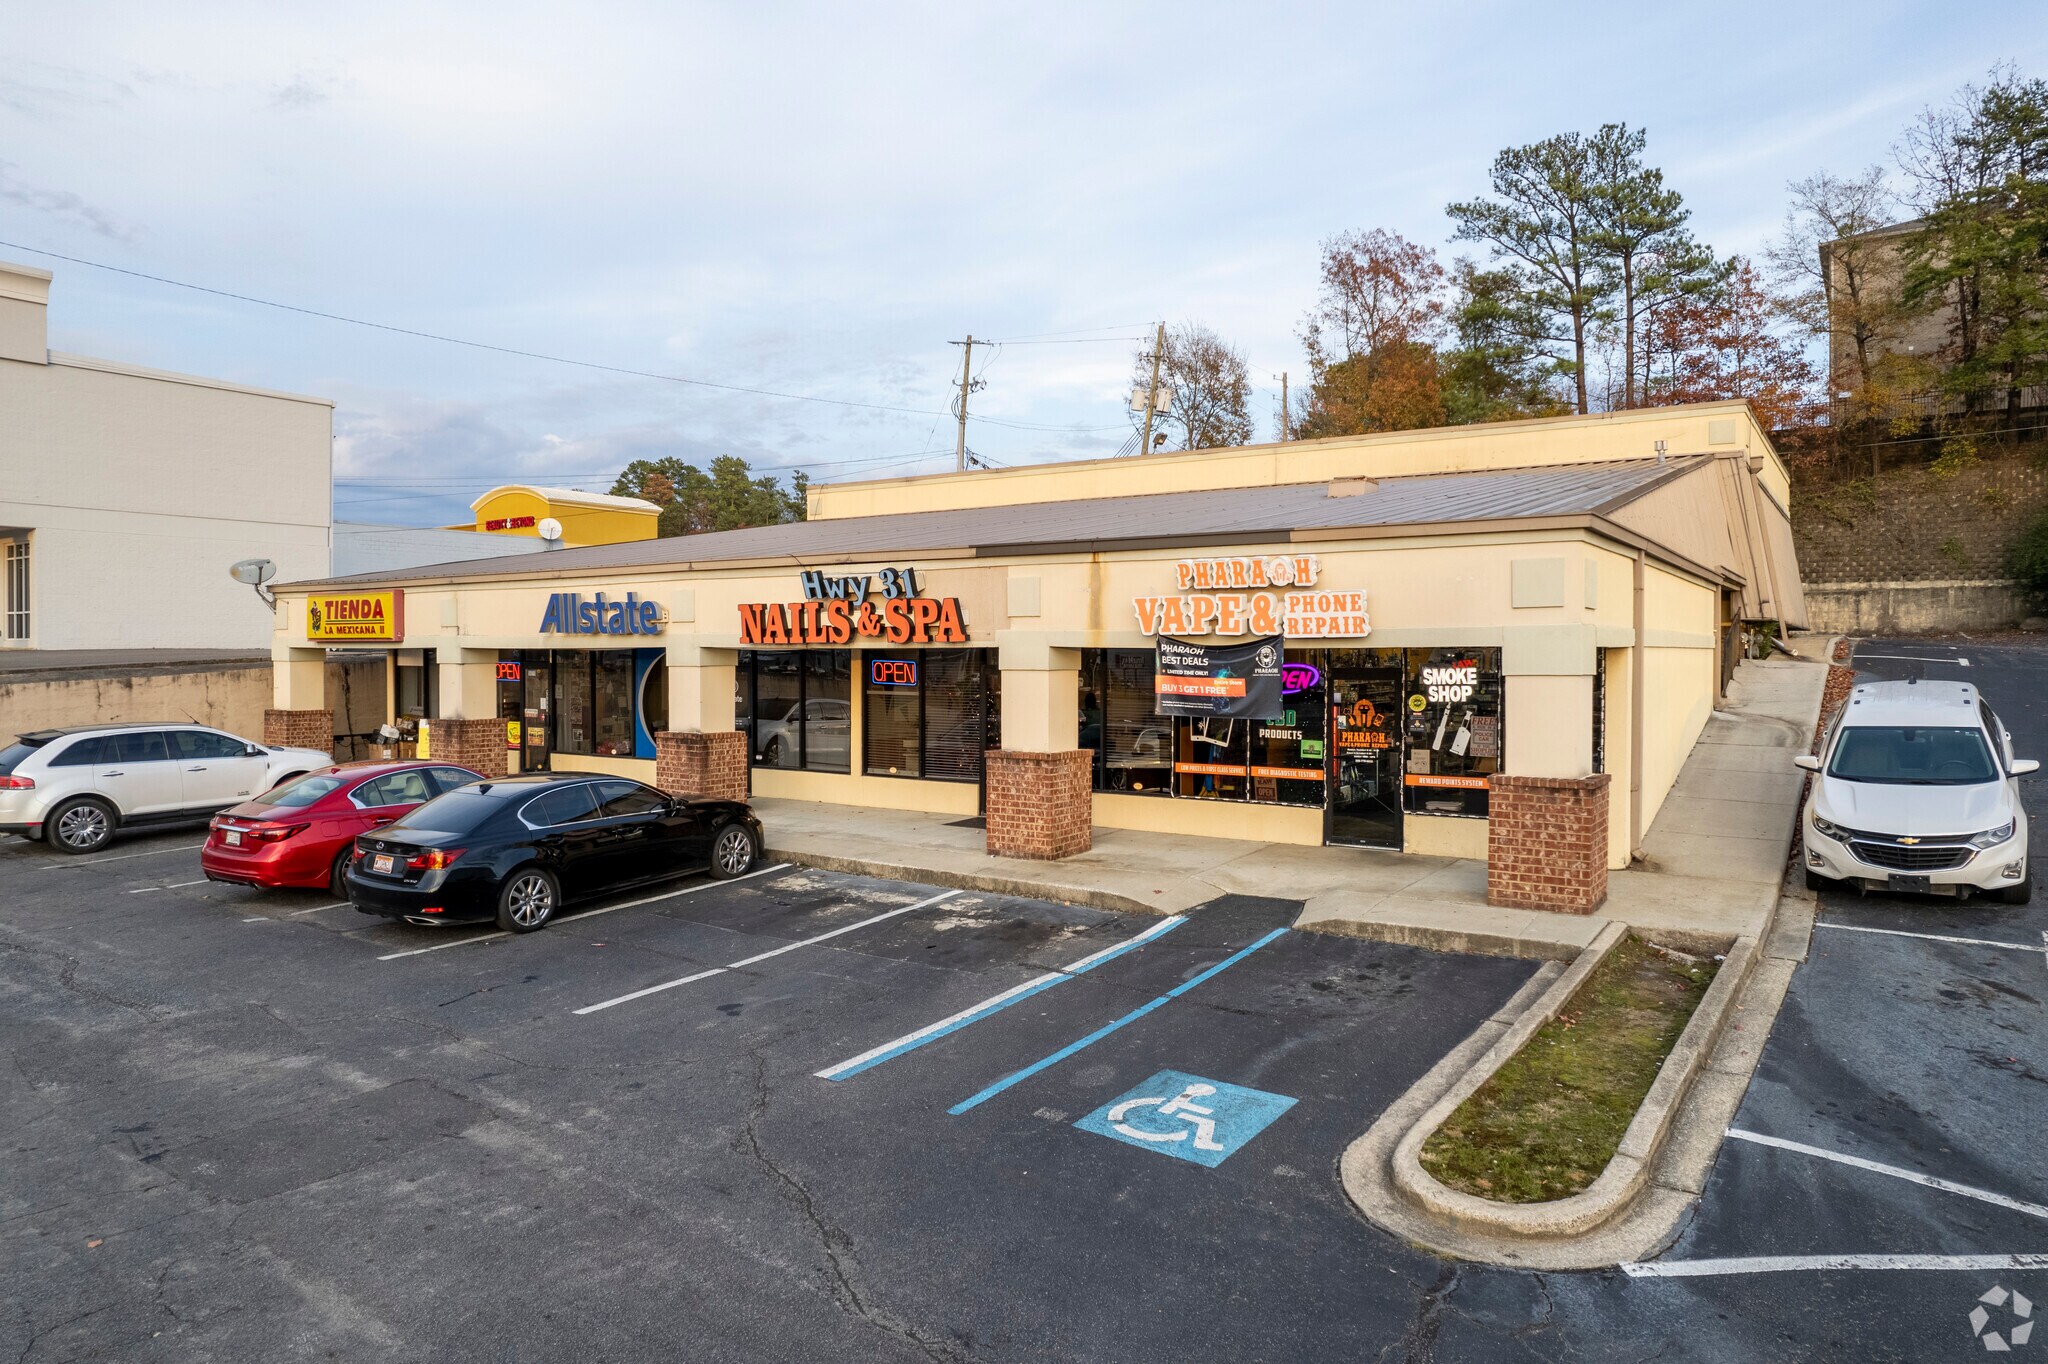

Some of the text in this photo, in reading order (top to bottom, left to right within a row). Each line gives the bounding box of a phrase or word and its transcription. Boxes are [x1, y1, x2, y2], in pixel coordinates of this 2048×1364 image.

[1176, 557, 1314, 589] PHARAOH
[801, 567, 919, 605] Hwy 31
[324, 599, 384, 620] TIENDA
[1289, 594, 1362, 613] PHONE
[539, 592, 661, 635] Allstate
[1134, 594, 1277, 635] VAPE &
[324, 626, 333, 635] LA
[336, 625, 376, 635] MEXICANA
[1287, 615, 1366, 635] REPAIR
[1161, 644, 1205, 656] PHARAOH
[1161, 656, 1209, 666] BEST DEALS
[495, 663, 520, 680] OPEN
[873, 662, 915, 683] OPEN
[1423, 667, 1477, 685] SMOKE
[1161, 684, 1178, 692] BUY
[1178, 684, 1183, 693] 3
[1184, 685, 1199, 693] GET
[1200, 686, 1205, 694] 1
[1428, 685, 1472, 702] SHOP
[1259, 728, 1303, 740] PRODUCTS
[1341, 731, 1386, 743] PHARAOH
[1270, 769, 1297, 777] DIAGNOSTIC
[1298, 770, 1317, 778] TESTING
[1418, 777, 1483, 787] REWARD POINTS SYSTEM
[1258, 788, 1273, 797] OPEN
